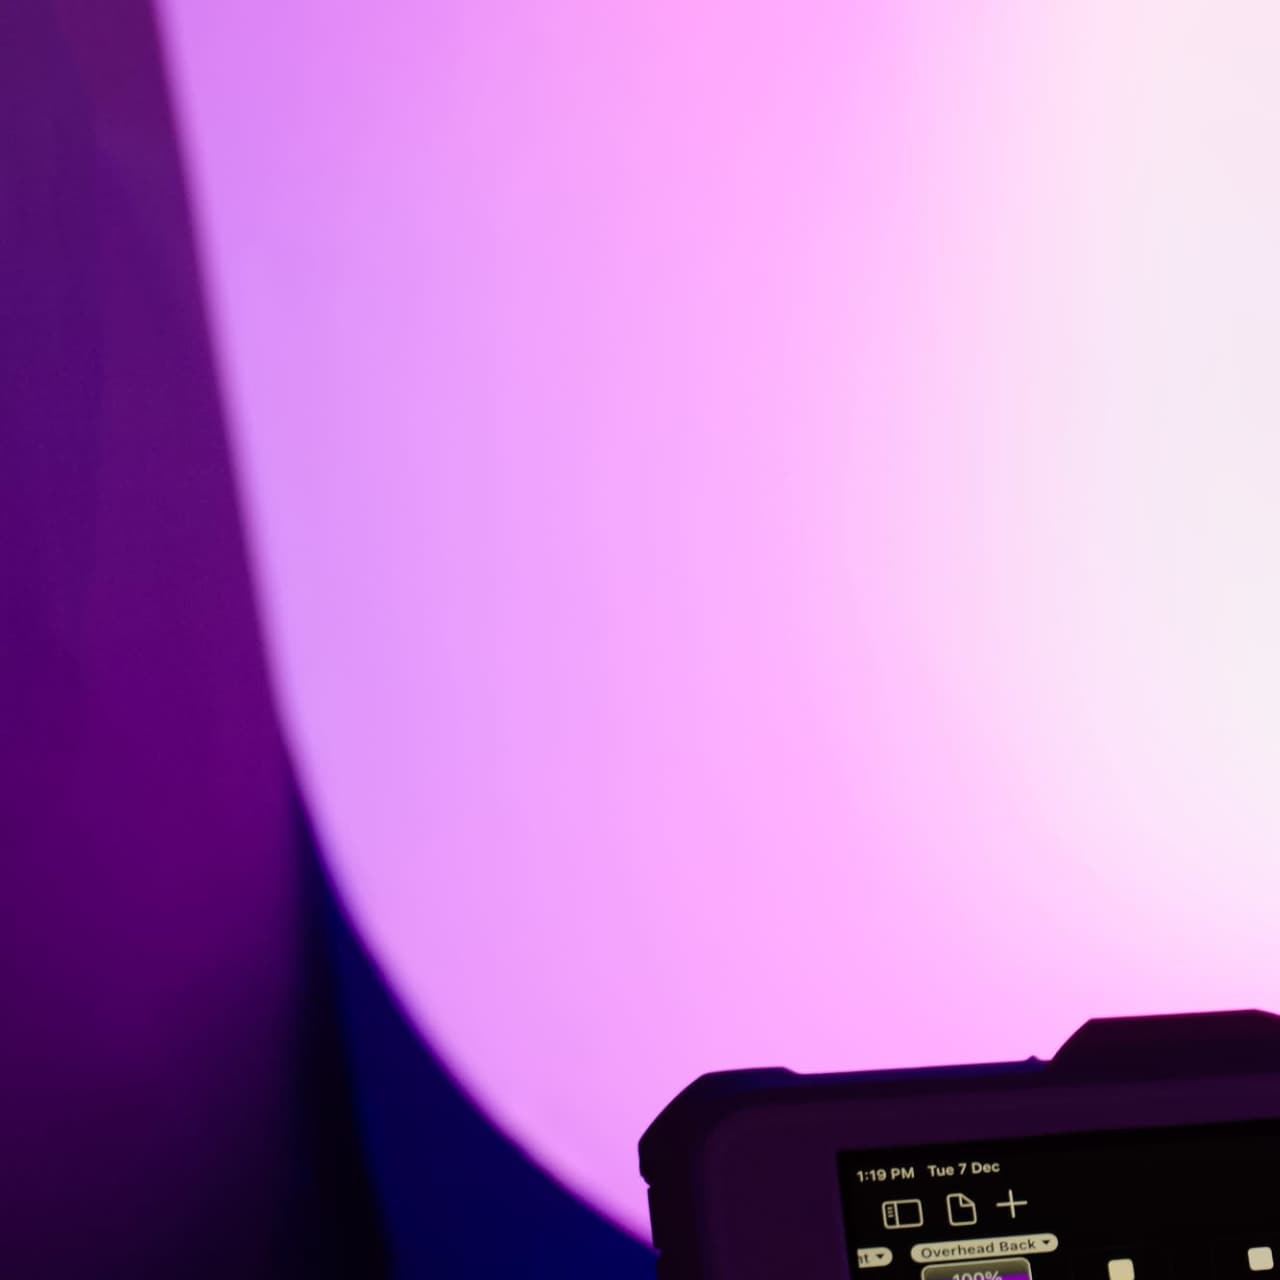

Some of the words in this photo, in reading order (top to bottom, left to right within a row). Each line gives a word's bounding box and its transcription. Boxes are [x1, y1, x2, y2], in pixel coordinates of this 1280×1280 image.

[856, 1168, 887, 1183] 1:19
[891, 1166, 915, 1181] PM
[928, 1164, 954, 1178] Tue
[958, 1163, 967, 1176] 7
[971, 1161, 1000, 1175] Dec
[920, 1241, 995, 1259] Overhead
[999, 1238, 1036, 1252] Back
